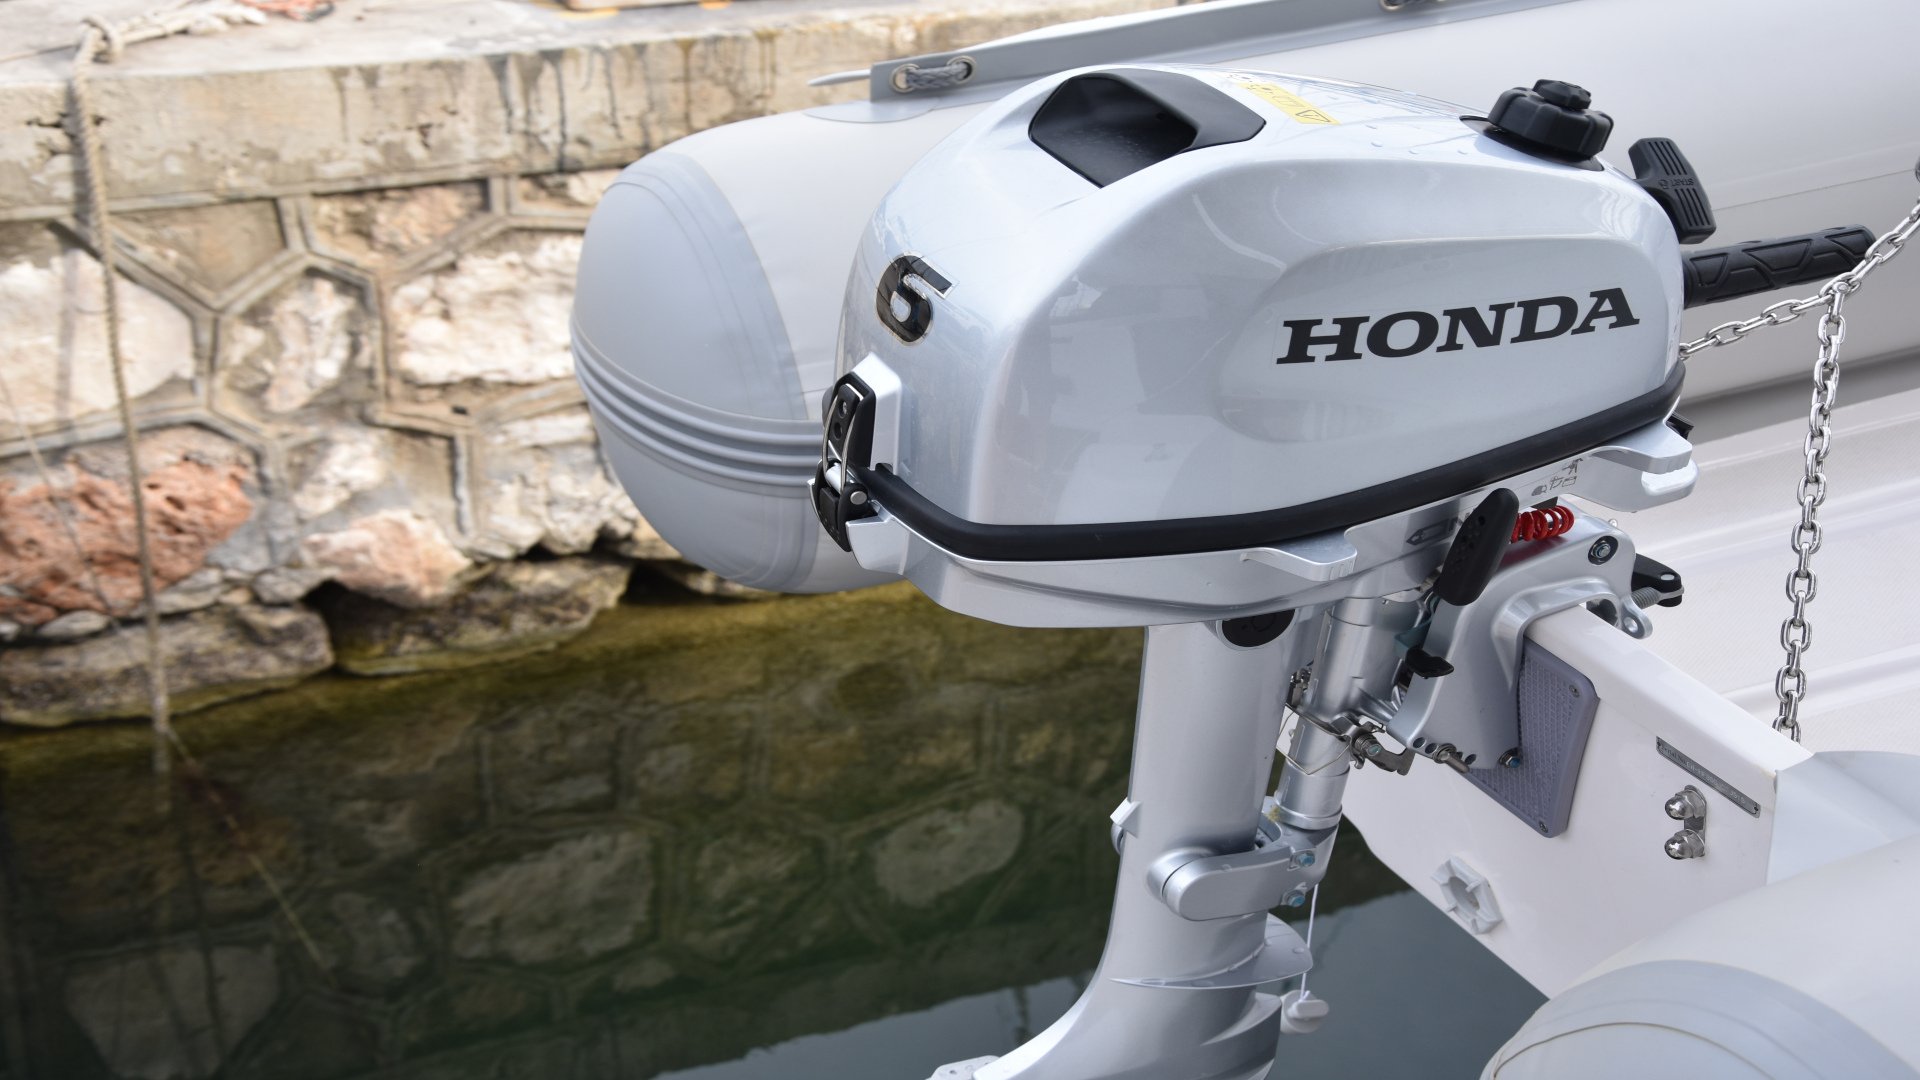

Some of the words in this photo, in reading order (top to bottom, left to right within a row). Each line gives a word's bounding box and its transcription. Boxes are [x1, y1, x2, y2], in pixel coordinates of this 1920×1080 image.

[1671, 178, 1695, 187] START
[876, 253, 955, 343] 6
[1276, 287, 1640, 364] HONDA
